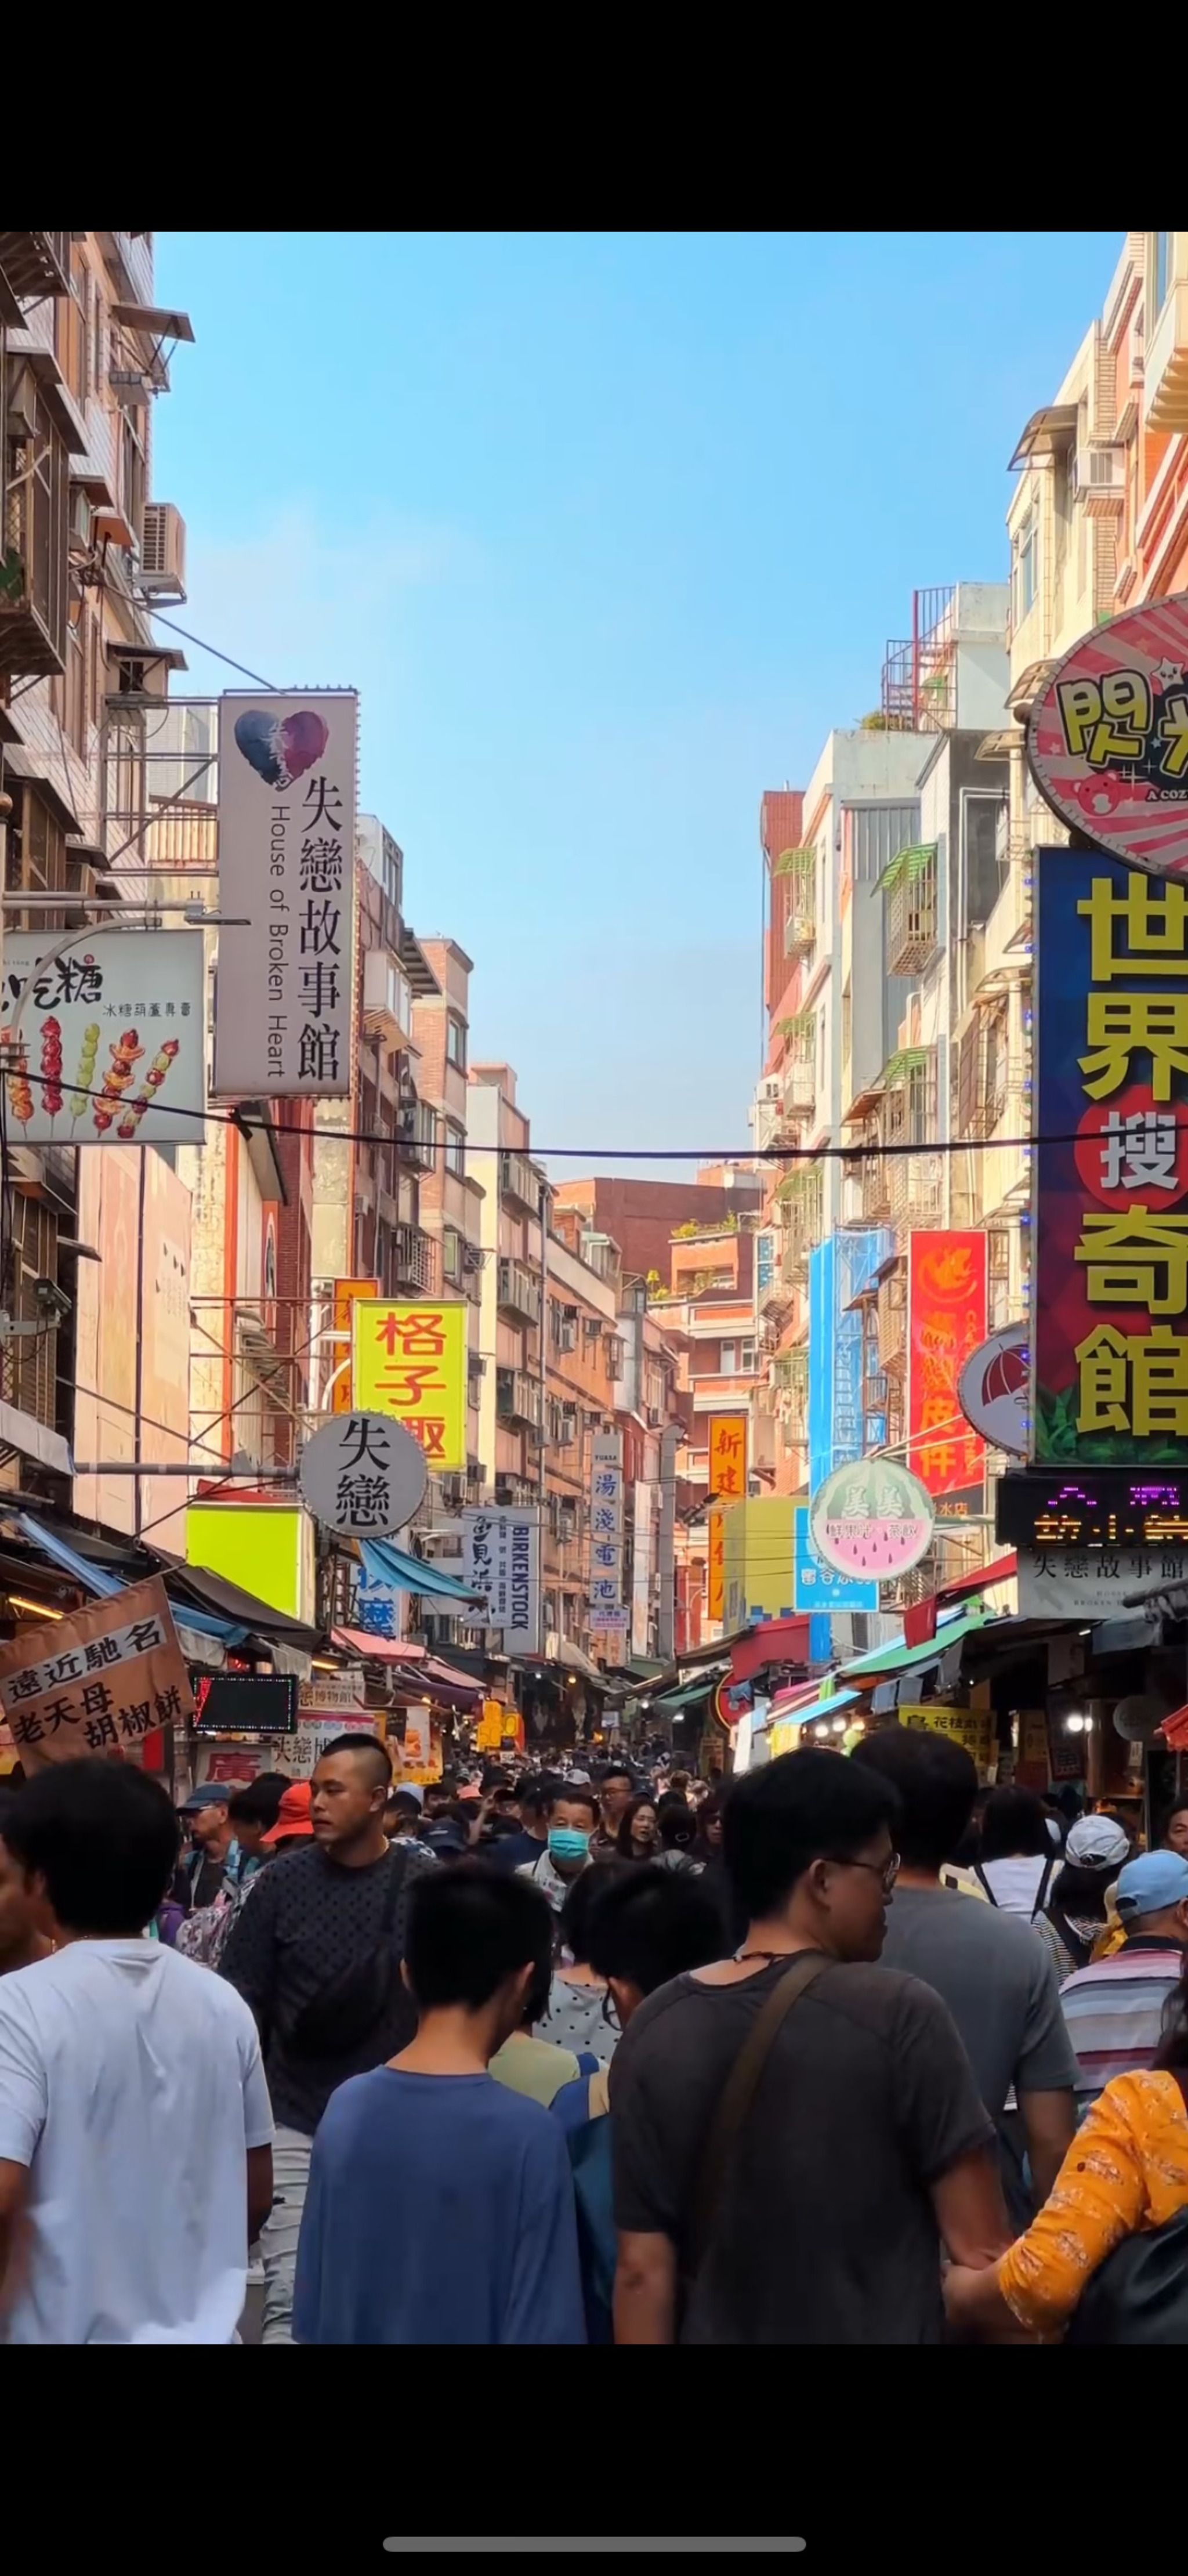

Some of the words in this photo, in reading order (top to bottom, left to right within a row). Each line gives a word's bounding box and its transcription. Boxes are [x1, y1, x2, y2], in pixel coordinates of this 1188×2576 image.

[1147, 790, 1158, 799] A
[1160, 789, 1188, 799] COZ
[270, 806, 290, 877] House
[269, 889, 289, 913] of
[297, 776, 343, 1081] 失戀故事館
[268, 924, 289, 1001] Broken
[267, 1015, 288, 1077] Heart
[1073, 871, 1188, 1439] 世界搜奇館
[335, 1417, 392, 1527] 失戀
[842, 1486, 902, 1517] 美美
[930, 1502, 968, 1516] 水店
[511, 1526, 530, 1630] BIRKENSTOCK
[1033, 1553, 1184, 1580] 失戀故事館
[8, 1620, 161, 1703] 遠近馳名
[14, 1681, 115, 1745] 老天母
[83, 1684, 182, 1749] 胡椒餅
